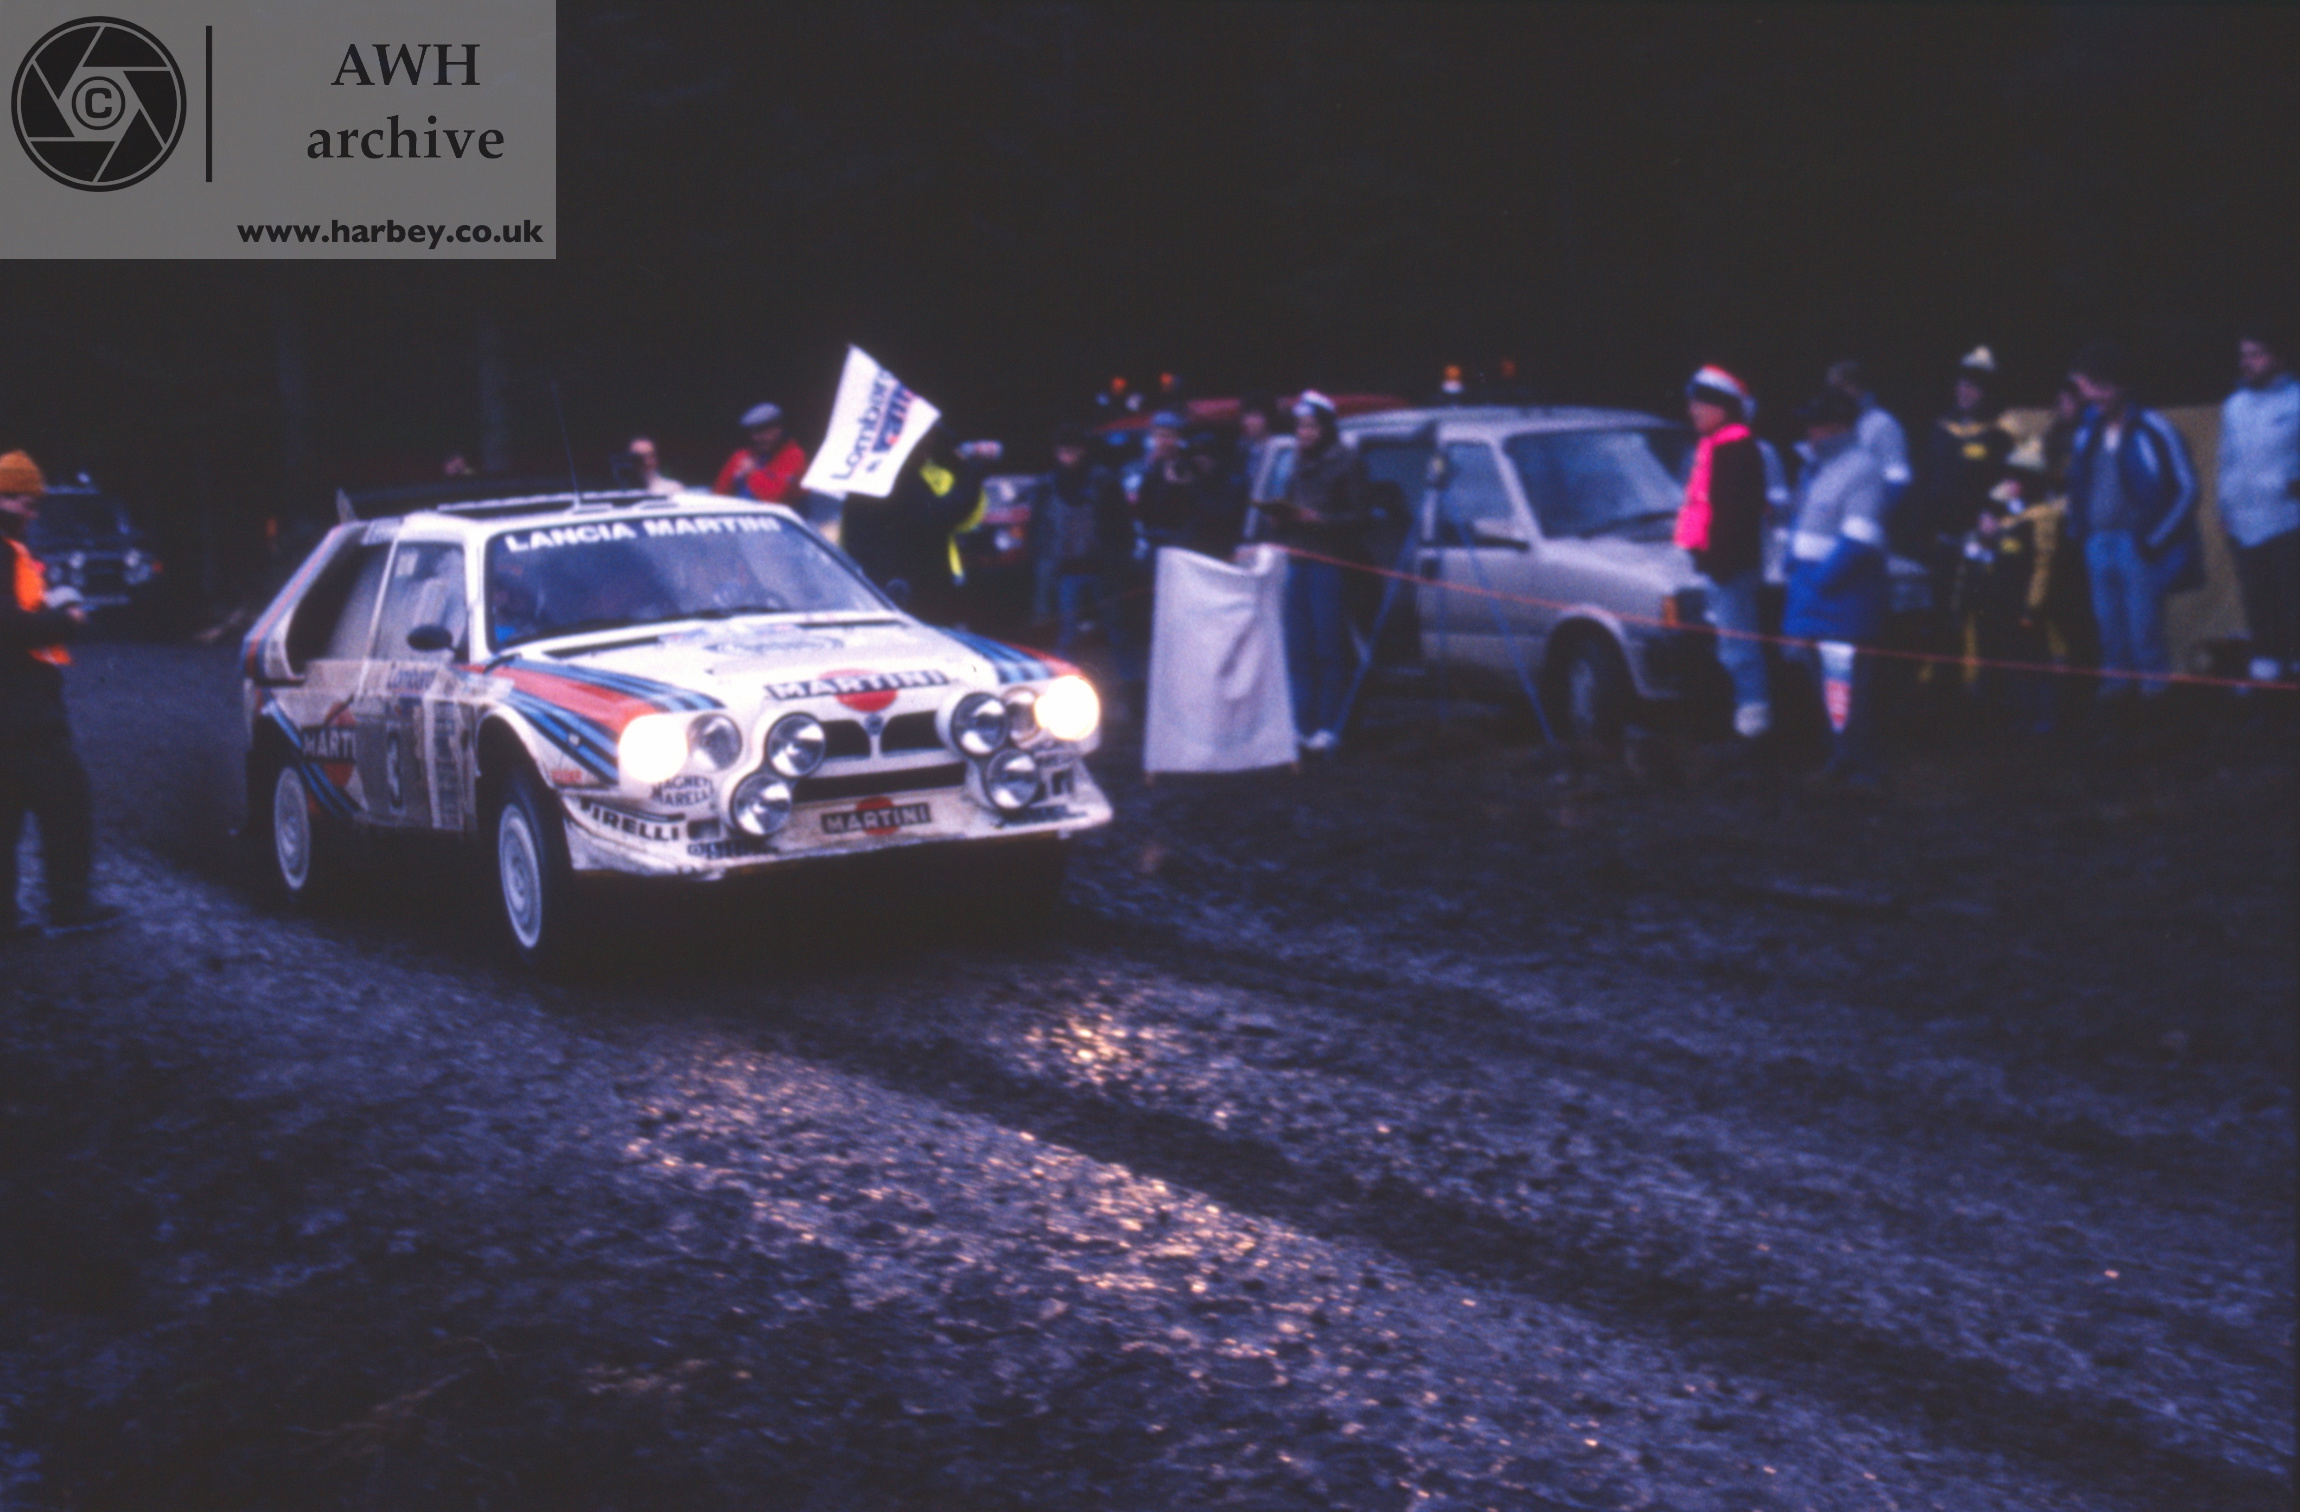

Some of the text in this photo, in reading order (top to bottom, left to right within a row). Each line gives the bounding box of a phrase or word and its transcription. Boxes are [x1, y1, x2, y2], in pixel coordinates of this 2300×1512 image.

[504, 516, 782, 553] LANCIA MARTINI
[770, 669, 946, 699] MARTINI
[826, 804, 928, 832] MARTINI
